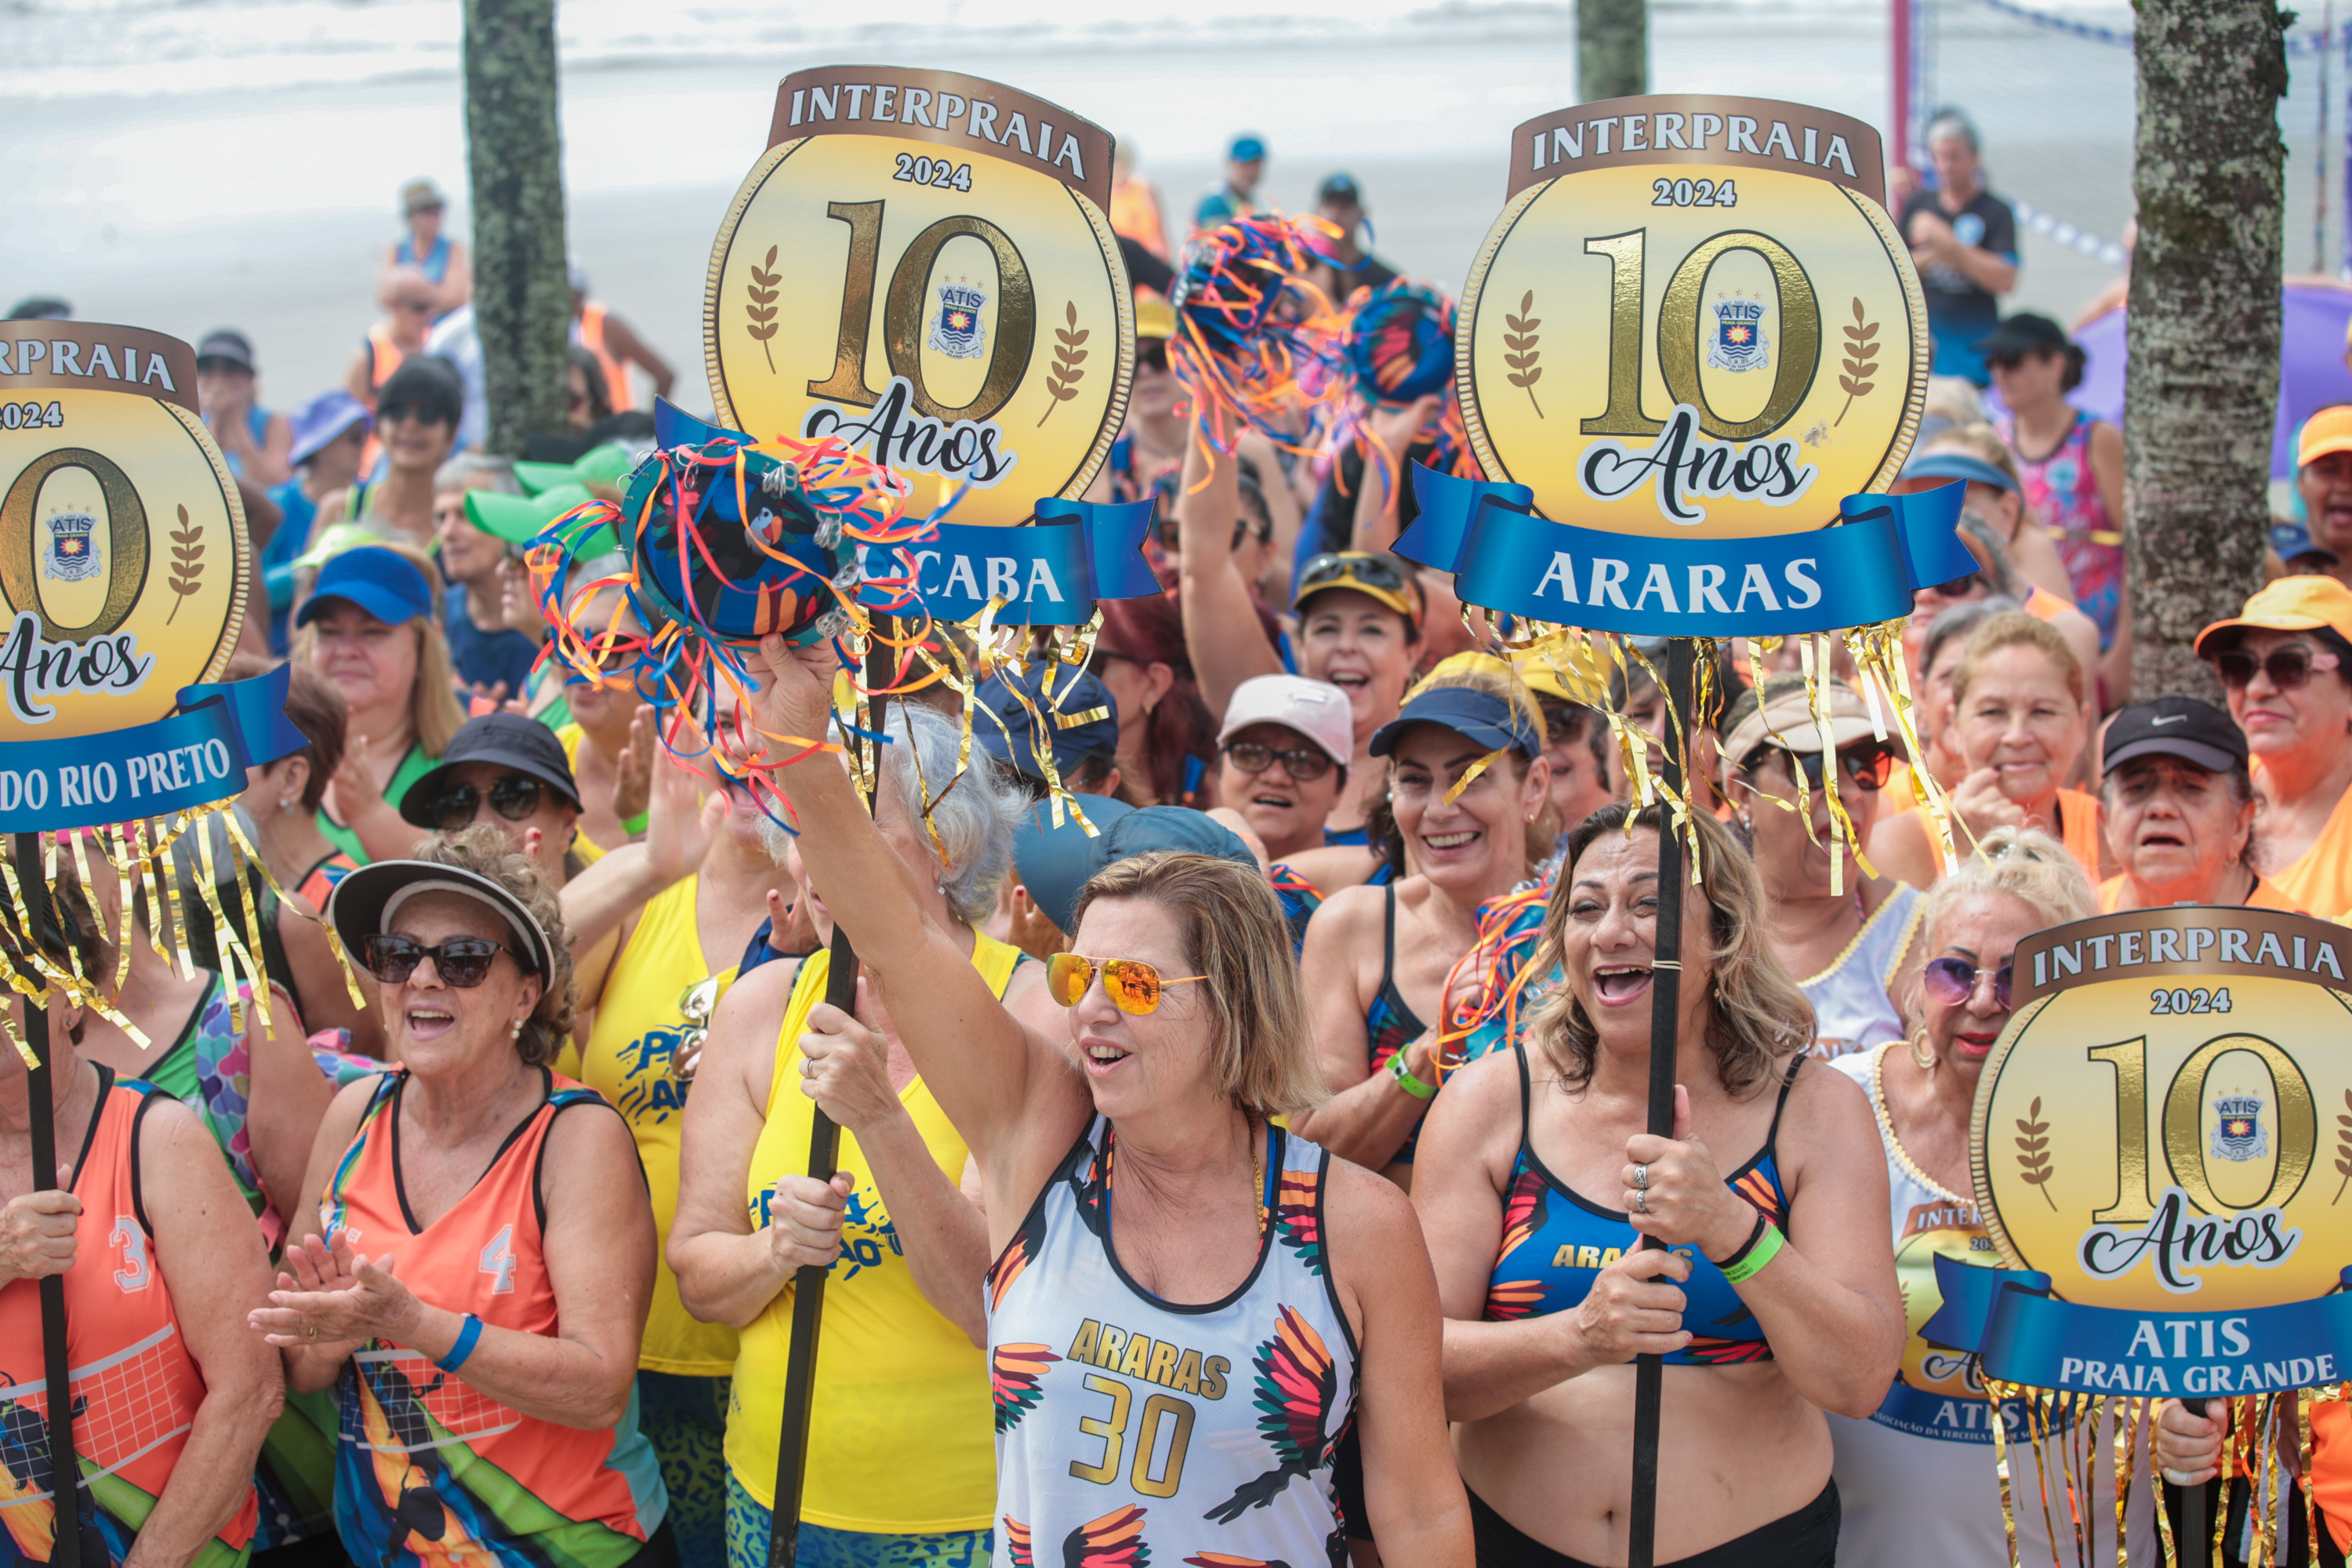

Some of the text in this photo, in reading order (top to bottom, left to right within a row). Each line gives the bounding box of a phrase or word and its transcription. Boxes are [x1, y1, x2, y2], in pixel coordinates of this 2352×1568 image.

[788, 83, 1087, 181] INTERPRAIA
[1531, 111, 1859, 179] INTERPRAIA
[892, 153, 973, 193] 2024
[1651, 178, 1737, 208] 2024
[806, 198, 1036, 426] 10
[942, 289, 982, 308] ATIS
[1719, 304, 1762, 319] ATIS
[1579, 226, 1823, 442] 10
[0, 401, 64, 430] 024
[803, 379, 1016, 493] Anos
[1580, 408, 1814, 521] Anos
[52, 517, 93, 532] ATIS
[1532, 550, 1823, 614] ARARAS
[0, 738, 230, 811] DO RIO PRETO
[2033, 927, 2347, 989] INTERPRAIA
[2150, 988, 2232, 1015] 2024
[2086, 1032, 2318, 1225] 10
[2219, 1100, 2259, 1114] ATIS
[108, 1214, 151, 1294] 3
[478, 1224, 517, 1295] 4
[2081, 1190, 2299, 1291] Anos
[1065, 1317, 1232, 1401] ARARAS
[2125, 1317, 2251, 1358] ATIS
[2059, 1354, 2338, 1393] PRAIA GRANDE
[1069, 1371, 1196, 1499] 30
[1926, 1427, 1940, 1437] DA
[1941, 1428, 1987, 1441] TERCEIRA
[1932, 1400, 2020, 1430] ATIS
